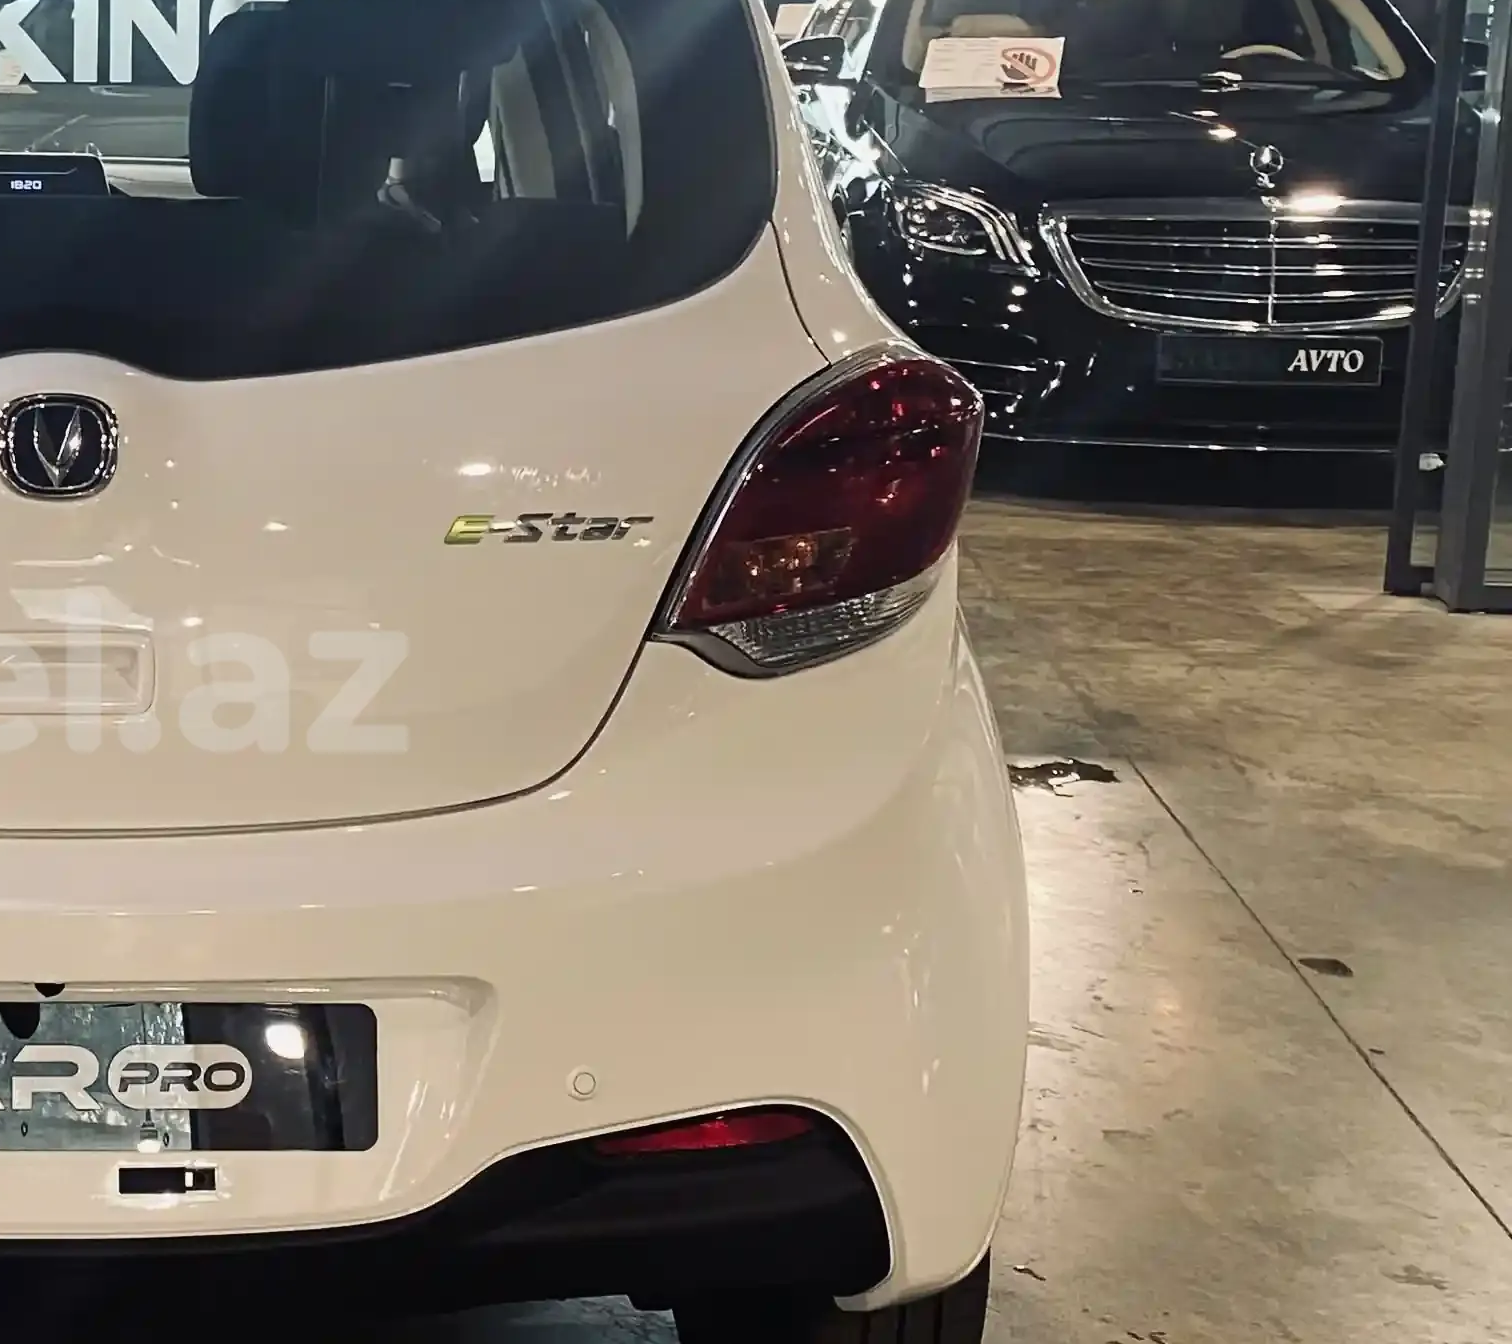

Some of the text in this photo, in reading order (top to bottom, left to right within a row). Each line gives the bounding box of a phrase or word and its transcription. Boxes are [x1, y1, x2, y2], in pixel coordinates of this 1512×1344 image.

[1288, 349, 1365, 373] AVTO
[443, 512, 655, 545] E-Star
[117, 1061, 246, 1093] PRO
